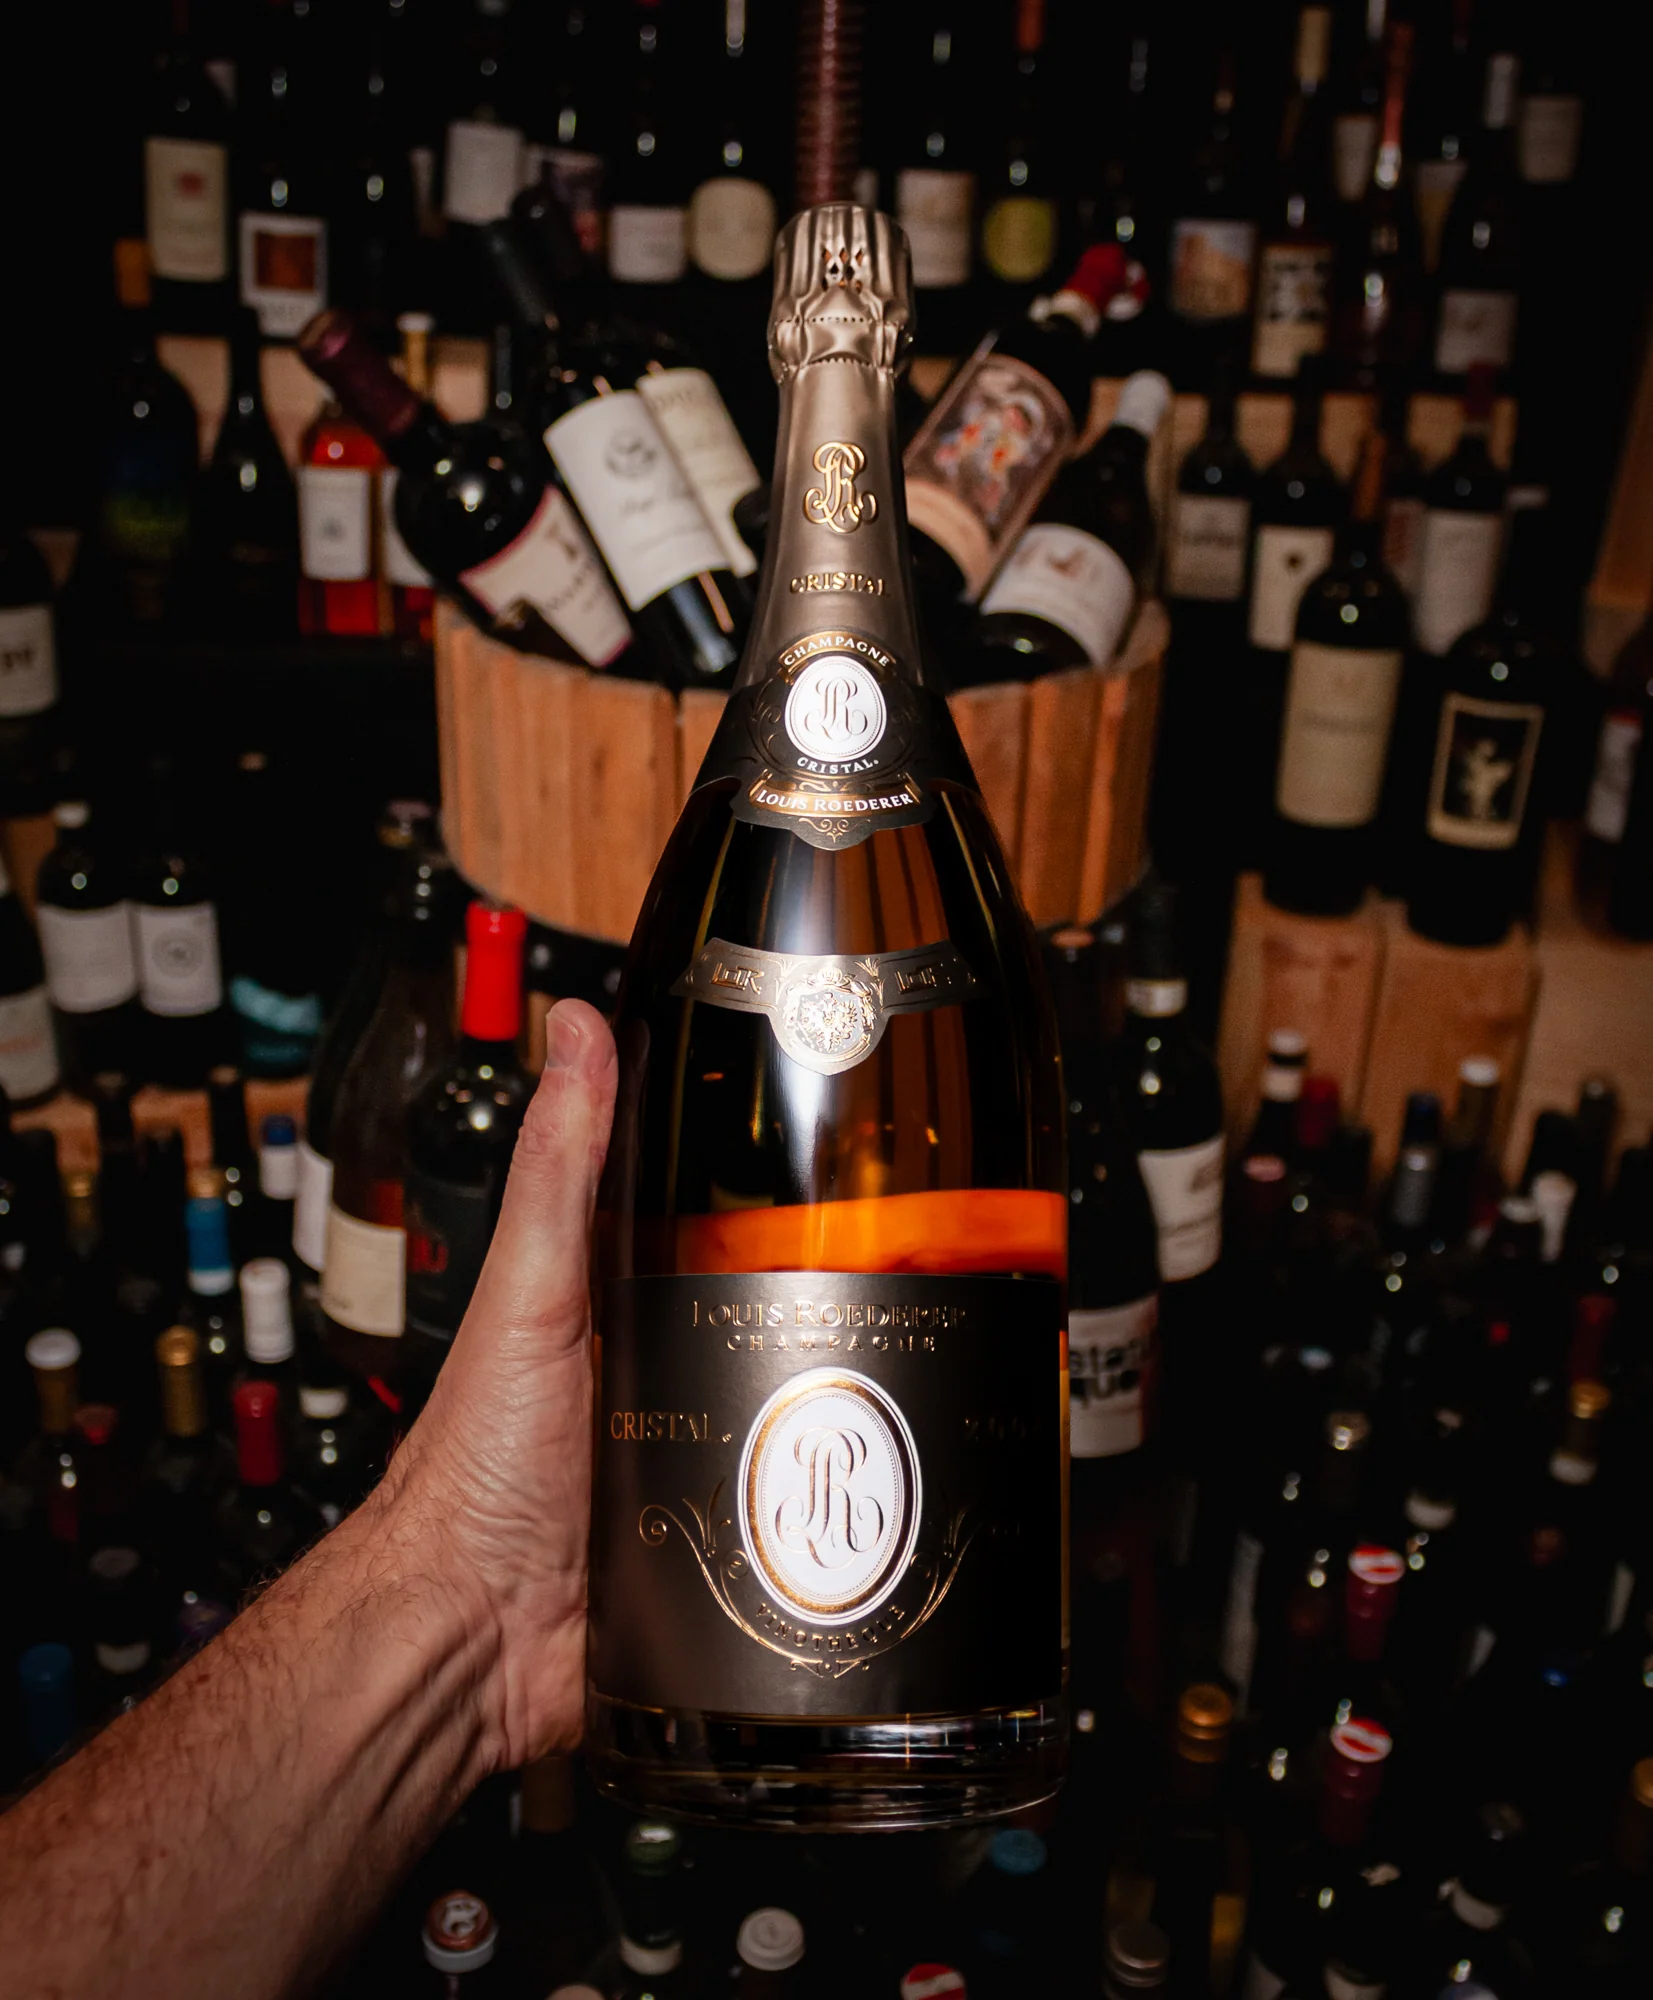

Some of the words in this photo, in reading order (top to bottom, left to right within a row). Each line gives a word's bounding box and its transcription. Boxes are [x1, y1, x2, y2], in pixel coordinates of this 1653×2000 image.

[784, 636, 889, 667] CHAMPAGNE
[757, 789, 808, 811] LOUIS
[813, 792, 914, 812] ROEDERER
[726, 1334, 937, 1352] CHAMPAGNE
